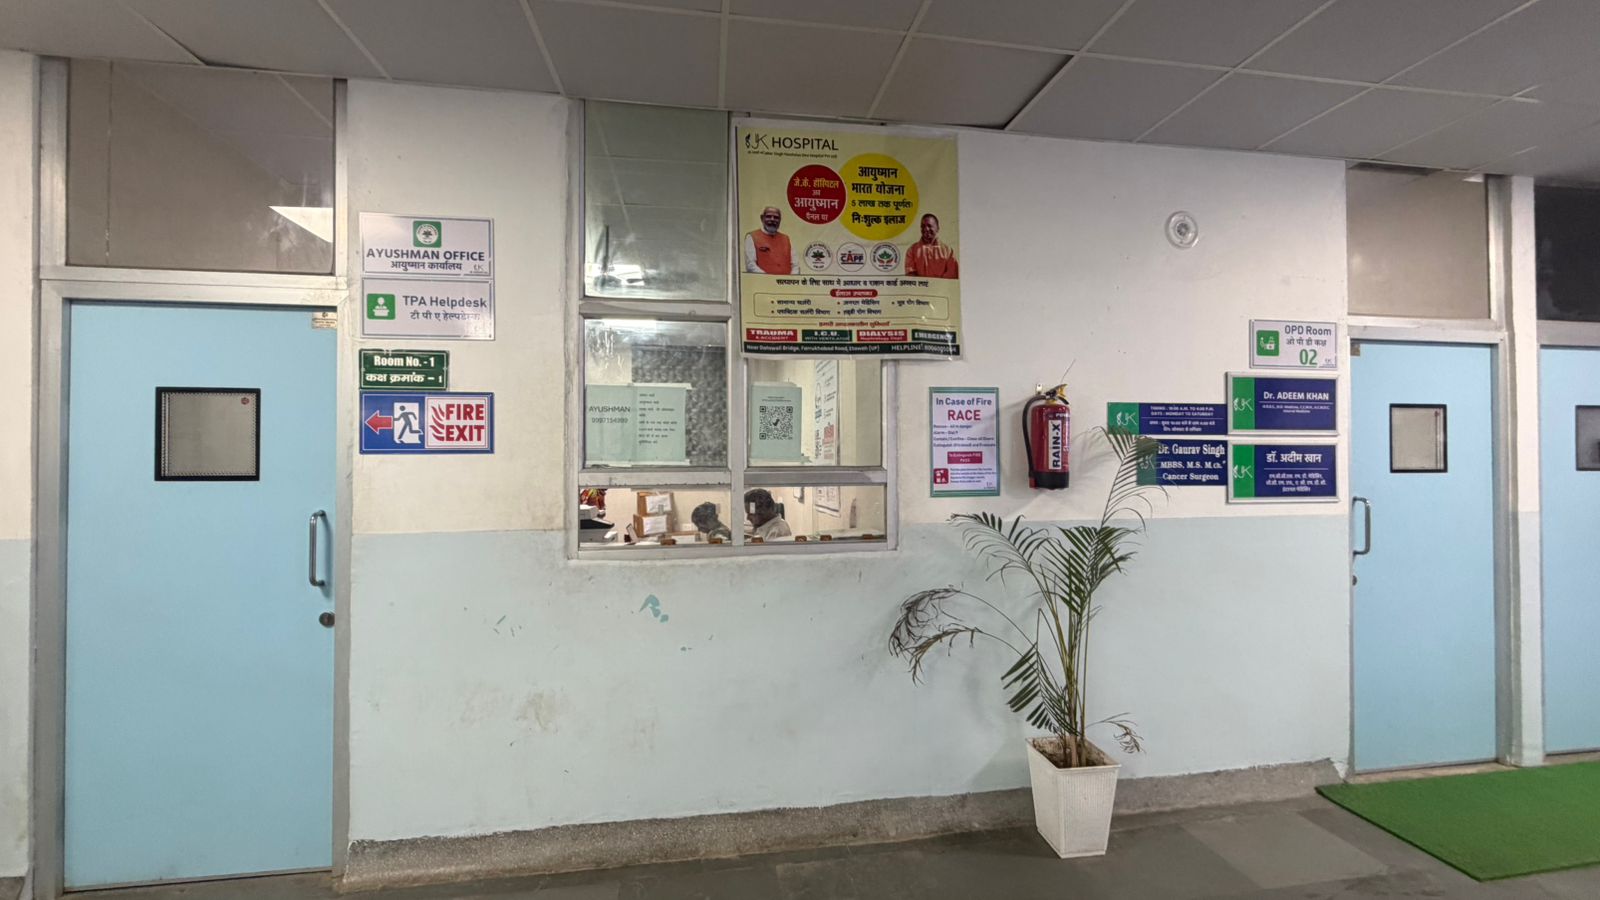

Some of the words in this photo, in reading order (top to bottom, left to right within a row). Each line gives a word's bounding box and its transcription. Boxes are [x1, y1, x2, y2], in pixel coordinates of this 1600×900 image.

[771, 137, 839, 151] HOSPITAL
[858, 166, 898, 181] आयुष्मान
[852, 182, 873, 194] भारत
[876, 181, 904, 195] योजना
[794, 196, 840, 212] आयुष्मान
[884, 214, 906, 224] इलाज
[366, 248, 440, 260] AYUSHMAN
[443, 250, 485, 261] OFFICE
[841, 251, 864, 262] CAPF
[391, 261, 426, 272] आयुष्मान
[428, 261, 462, 270] कार्यालय
[402, 296, 427, 306] TPA
[430, 296, 488, 310] Helpdesk
[410, 310, 420, 320] टी
[422, 310, 432, 320] पी
[434, 312, 442, 321] ए
[1284, 324, 1304, 335] OPD
[1306, 326, 1332, 336] Room
[1286, 336, 1294, 345] ओ
[1296, 336, 1304, 346] पी
[1305, 337, 1312, 346] डी
[1314, 338, 1327, 346] कक्ष
[373, 355, 404, 366] Room
[405, 356, 422, 367] No.
[430, 356, 435, 367] 1
[1300, 348, 1318, 366] 02
[365, 374, 387, 382] कक्ष
[390, 372, 426, 383] क्रमांक
[936, 398, 944, 406] In
[945, 398, 965, 406] Case
[966, 397, 974, 406] of
[976, 398, 992, 406] Fire
[1264, 392, 1275, 400] Dr.
[1277, 392, 1305, 400] ADEEM
[1306, 392, 1330, 401] KHAN
[446, 403, 484, 420] FIRE
[948, 410, 982, 421] RACE
[446, 424, 484, 442] EXIT
[1052, 424, 1061, 468] RAIN-X
[1158, 444, 1170, 454] Dr.
[1172, 444, 1200, 454] Gaurav
[1202, 444, 1225, 457] Singh
[1266, 450, 1278, 463] डॉ.
[1280, 451, 1302, 463] अदीम
[1304, 453, 1322, 464] खान
[1186, 461, 1203, 470] M.S.
[1189, 472, 1219, 482] Surgeon
